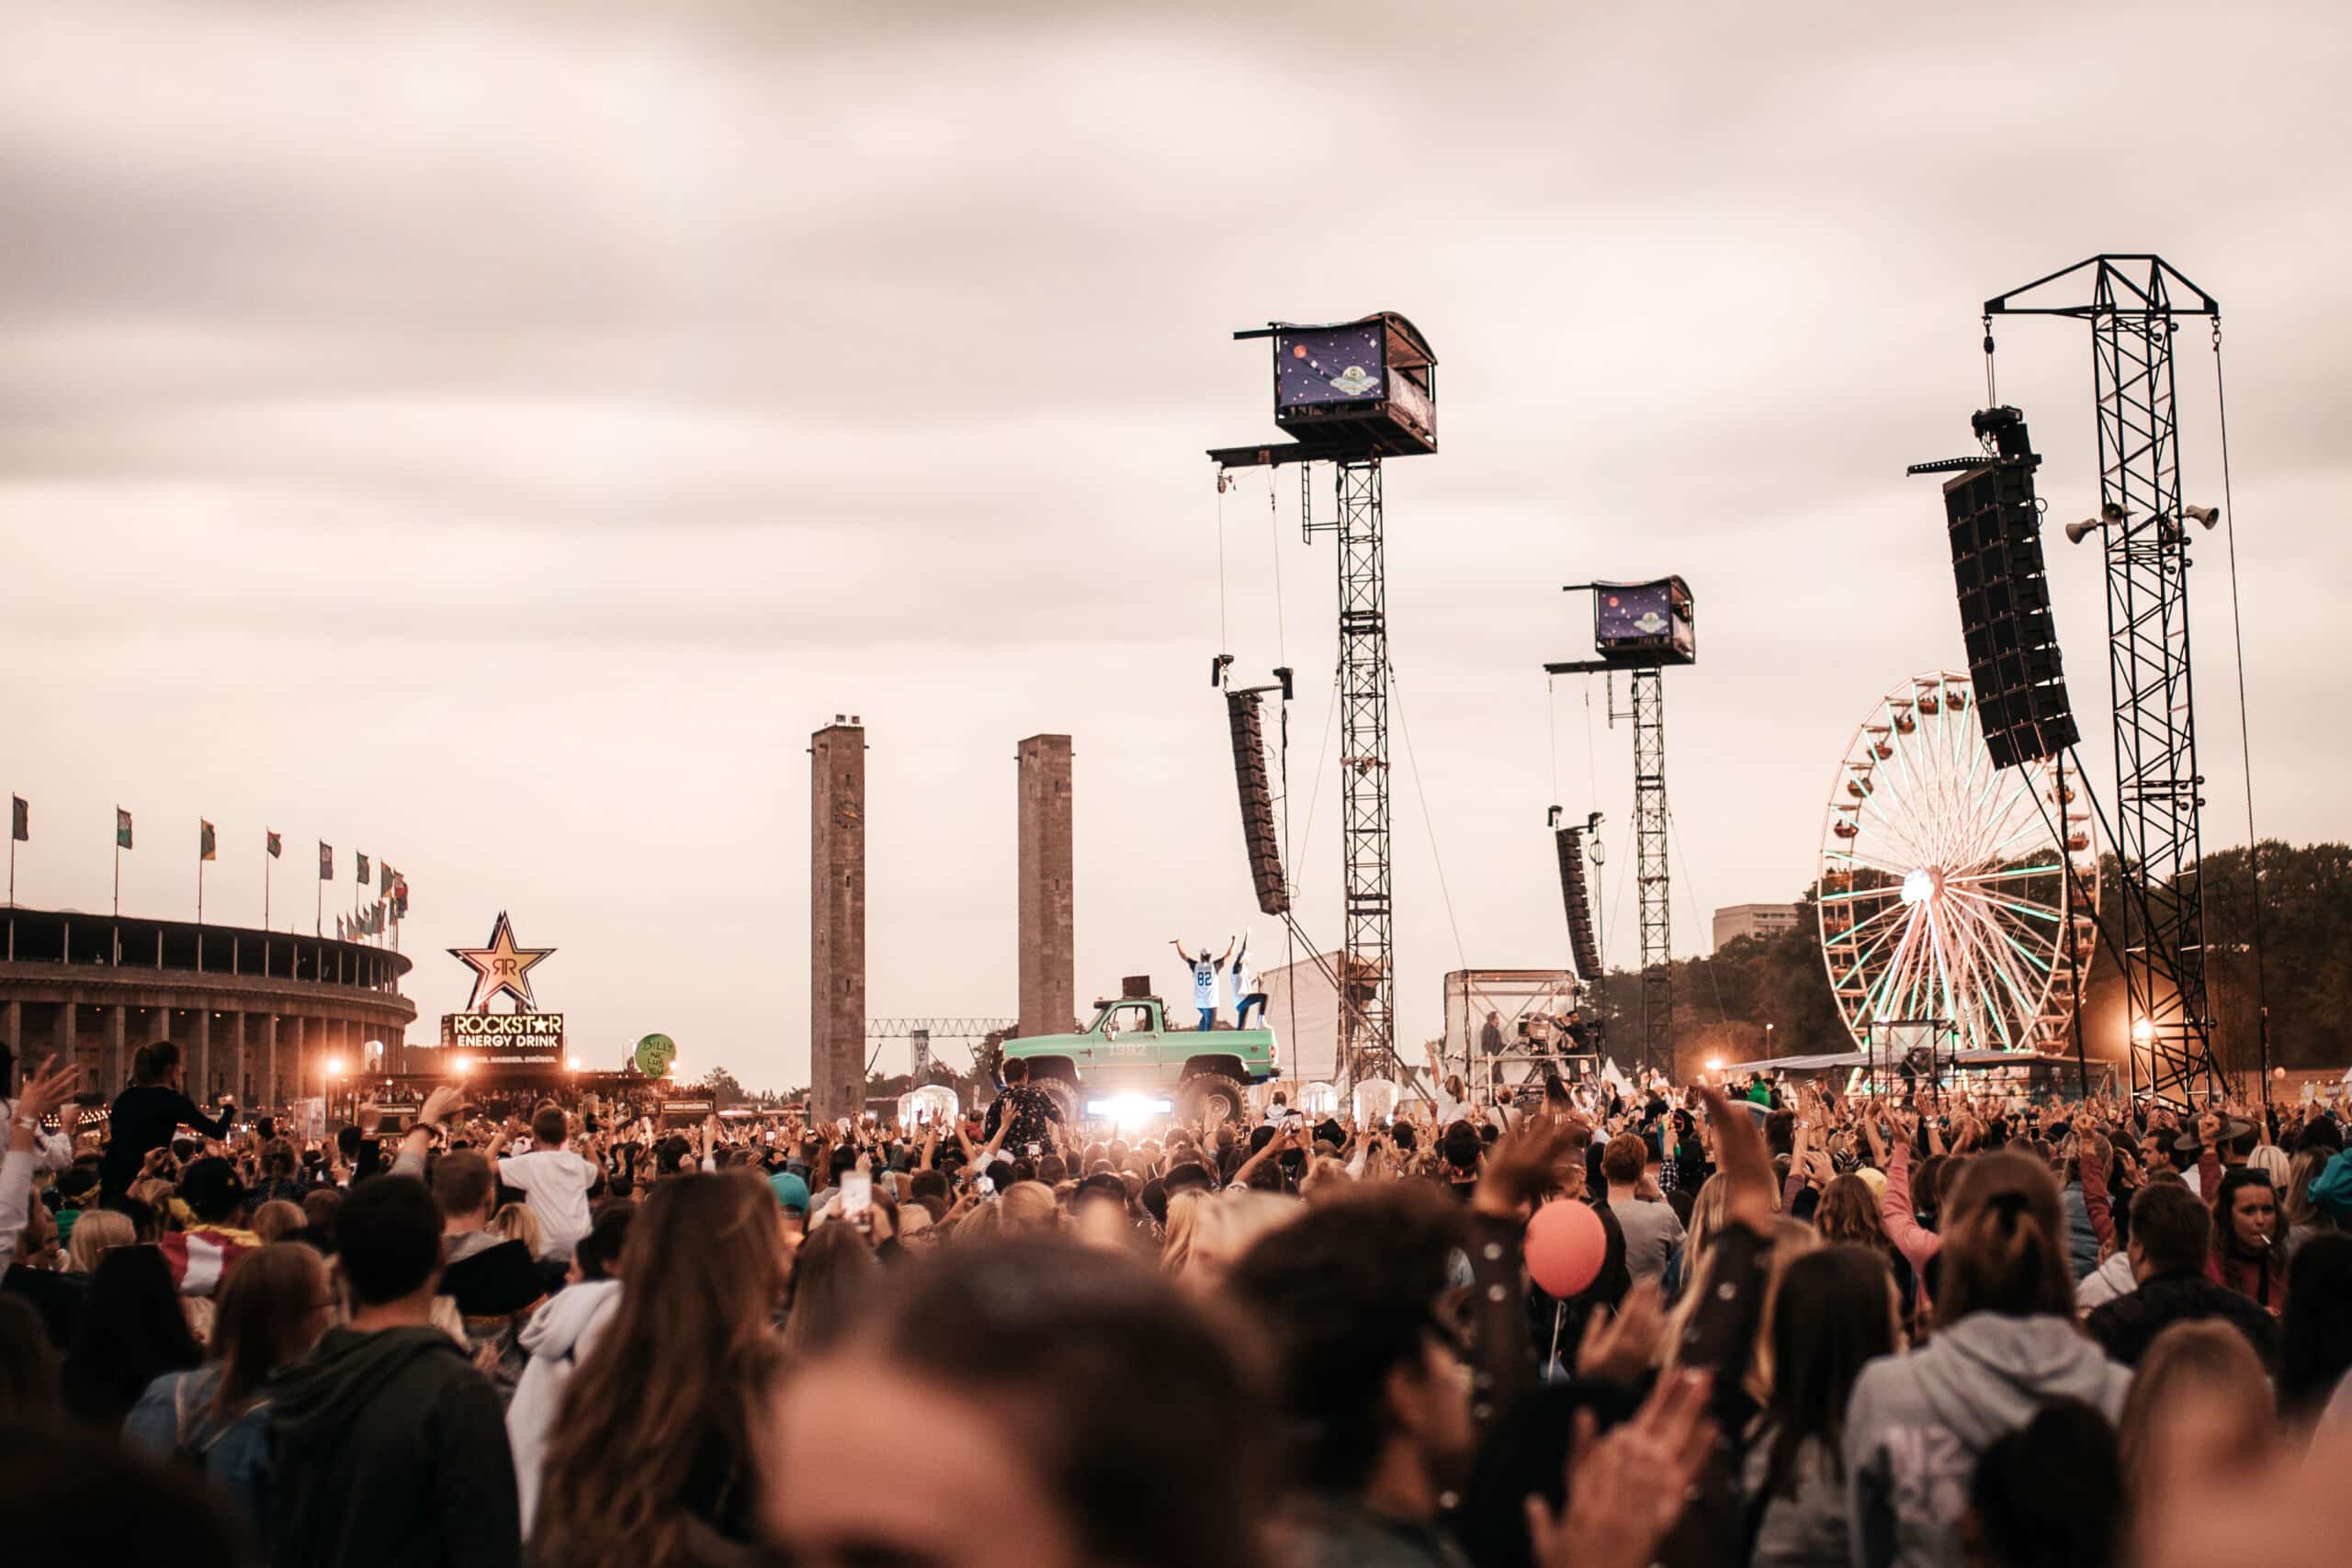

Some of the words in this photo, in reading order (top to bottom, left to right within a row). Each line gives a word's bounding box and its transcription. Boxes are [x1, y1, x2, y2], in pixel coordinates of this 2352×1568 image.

[1198, 971, 1213, 987] 82
[457, 1035, 513, 1047] ENERGY
[516, 1035, 559, 1047] DRINK
[1109, 1043, 1147, 1056] 1982
